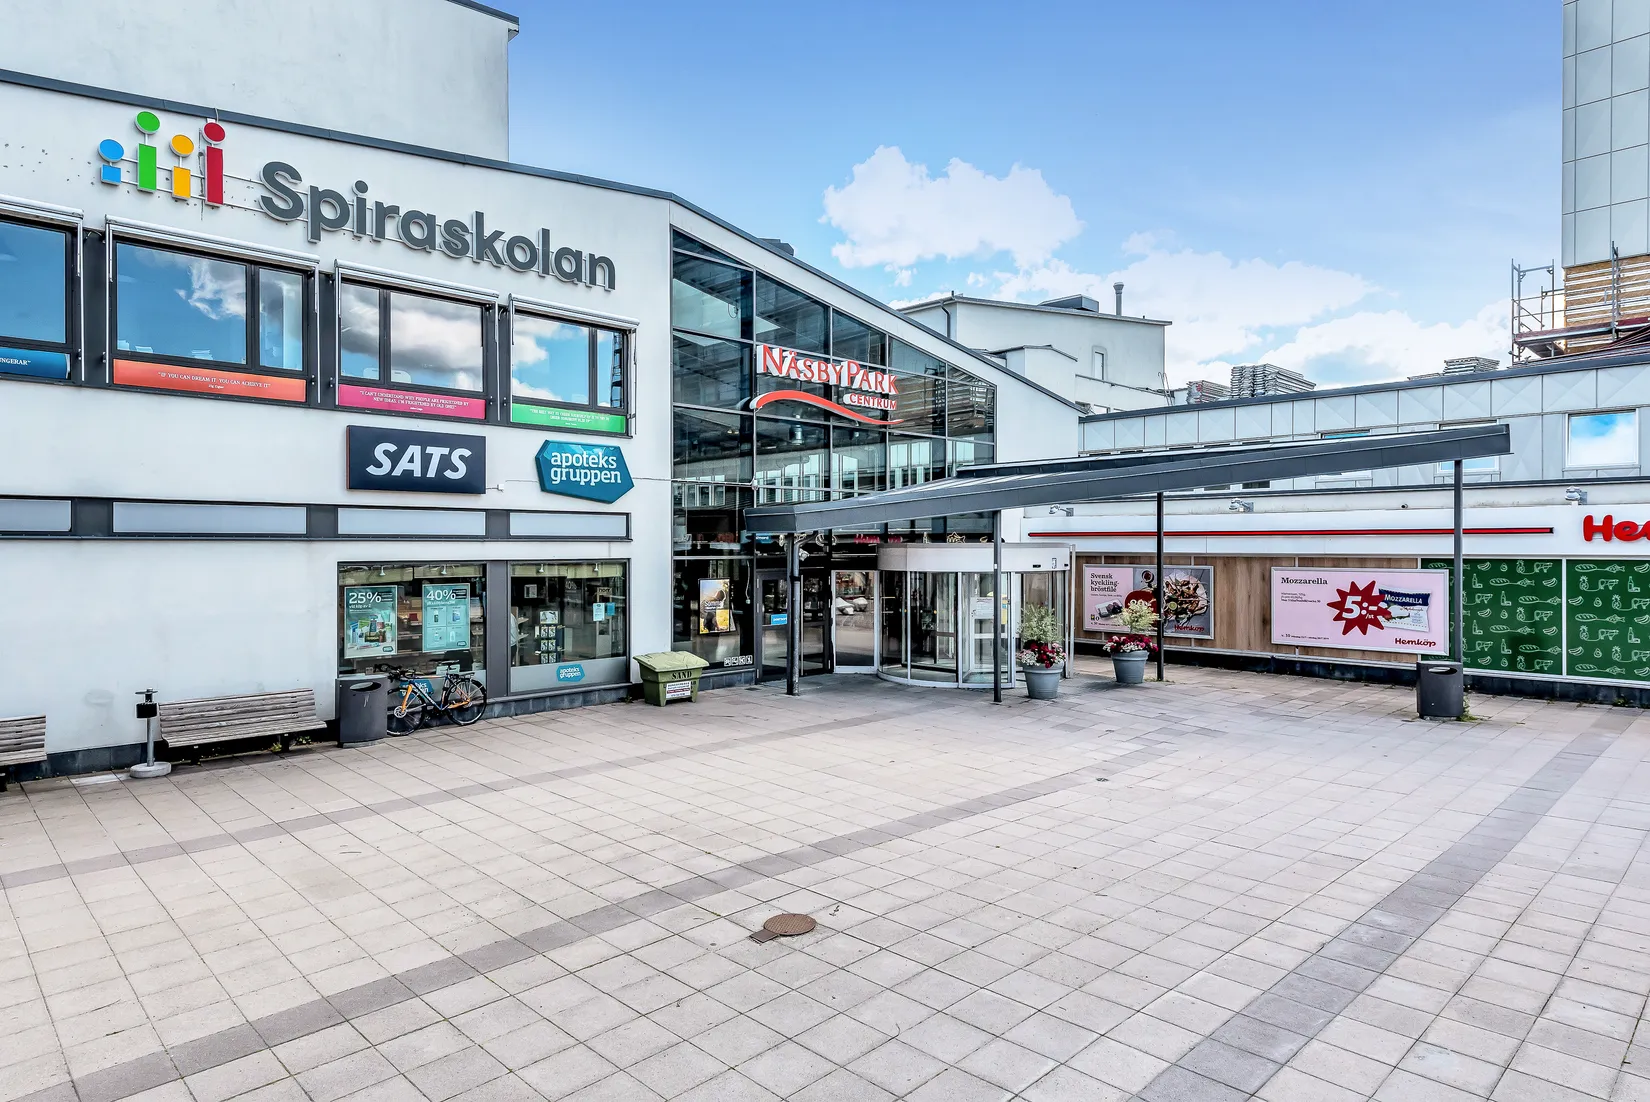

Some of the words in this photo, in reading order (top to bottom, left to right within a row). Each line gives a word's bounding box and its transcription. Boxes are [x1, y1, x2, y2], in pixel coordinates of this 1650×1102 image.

[260, 161, 616, 291] Spiraskolan
[849, 393, 897, 410] CENTRUM
[366, 442, 472, 480] SATS
[551, 451, 617, 469] apoteks
[551, 467, 622, 486] gruppen
[1583, 515, 1650, 542] He
[1281, 577, 1328, 585] Mozzarella
[349, 592, 381, 603] 25%
[426, 589, 456, 600] 40%
[1385, 594, 1422, 604] MOZZARELLA
[1395, 637, 1436, 647] Hemköp
[671, 671, 692, 680] SAND
